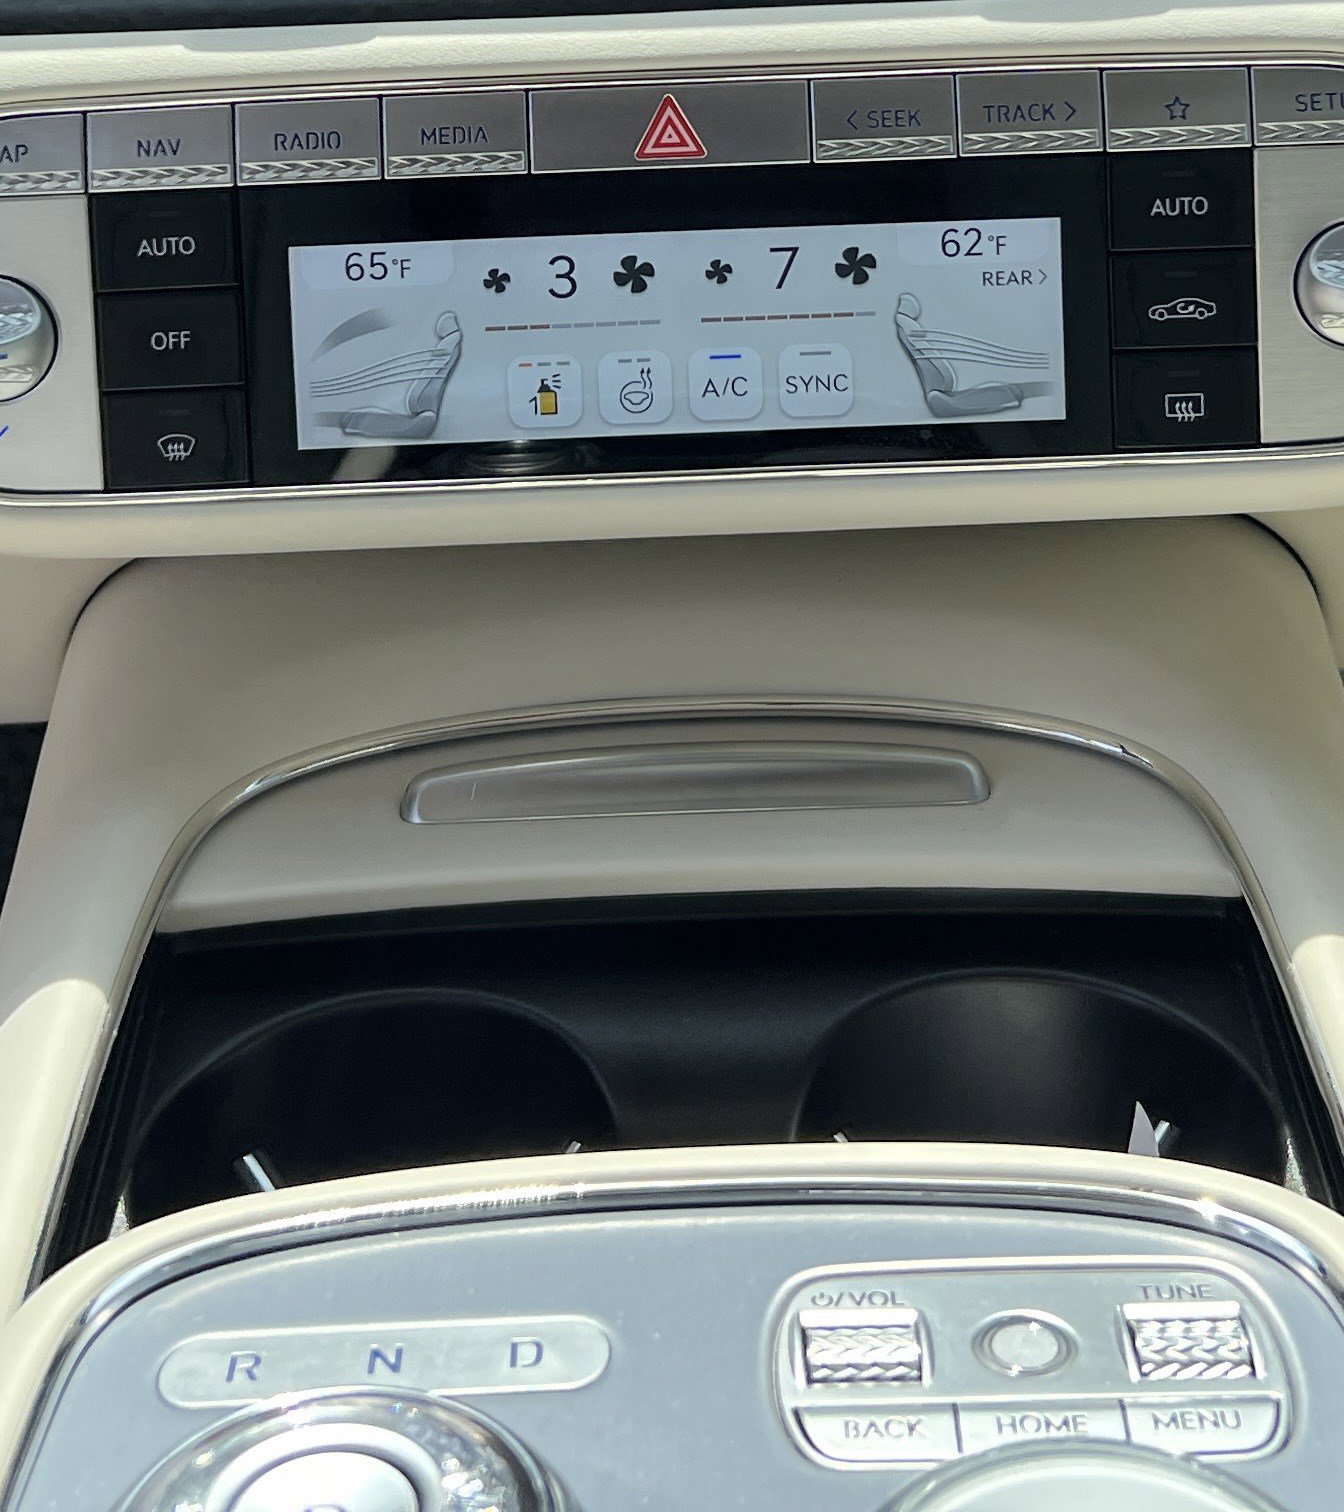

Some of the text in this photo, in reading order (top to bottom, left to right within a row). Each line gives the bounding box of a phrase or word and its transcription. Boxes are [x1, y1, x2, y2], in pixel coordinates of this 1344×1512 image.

[866, 108, 921, 130] SEEK
[982, 103, 1056, 125] TRACK
[273, 130, 342, 152] RADIO
[419, 125, 489, 147] MEDIA
[136, 137, 181, 159] NAV
[1150, 195, 1208, 217] AUTO
[137, 236, 196, 258] AUTO
[547, 255, 578, 299] 3
[768, 246, 800, 290] 7
[981, 270, 1034, 288] REAR
[150, 330, 191, 351] OFF
[701, 374, 749, 400] A/C
[784, 372, 849, 395] SYNC
[1137, 1283, 1214, 1301] TUNE
[225, 1336, 545, 1383] R N D
[843, 1418, 928, 1439] BACK
[995, 1413, 1089, 1435] HOME
[1151, 1410, 1242, 1431] MENU
